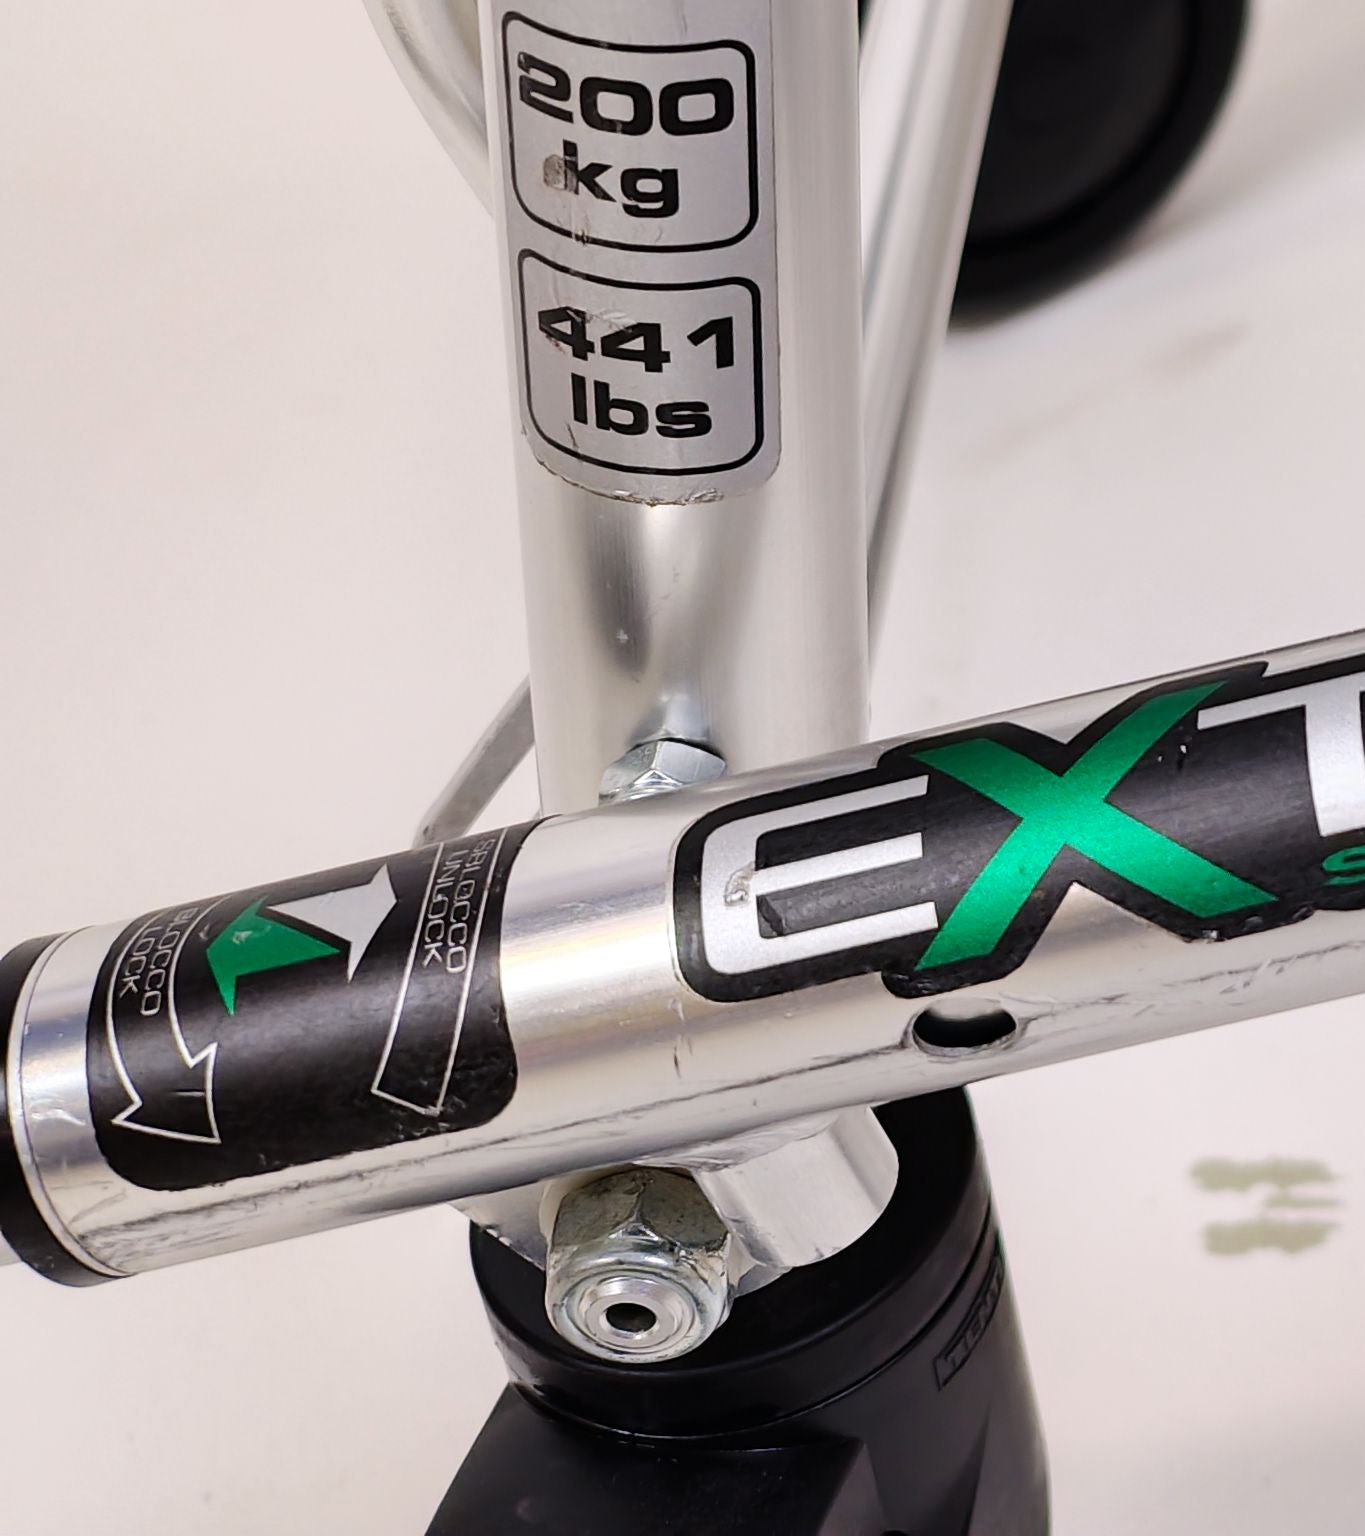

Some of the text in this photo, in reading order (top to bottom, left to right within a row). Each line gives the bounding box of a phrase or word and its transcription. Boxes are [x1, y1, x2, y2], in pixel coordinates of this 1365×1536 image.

[517, 51, 735, 137] 200
[562, 139, 680, 218] kg
[538, 305, 735, 374] 441
[571, 373, 713, 439] lbs
[422, 849, 470, 970] UNLOCK
[446, 838, 497, 974] SBLOCCO
[119, 925, 163, 1000] LOCK
[140, 907, 199, 1016] BLOCCO
